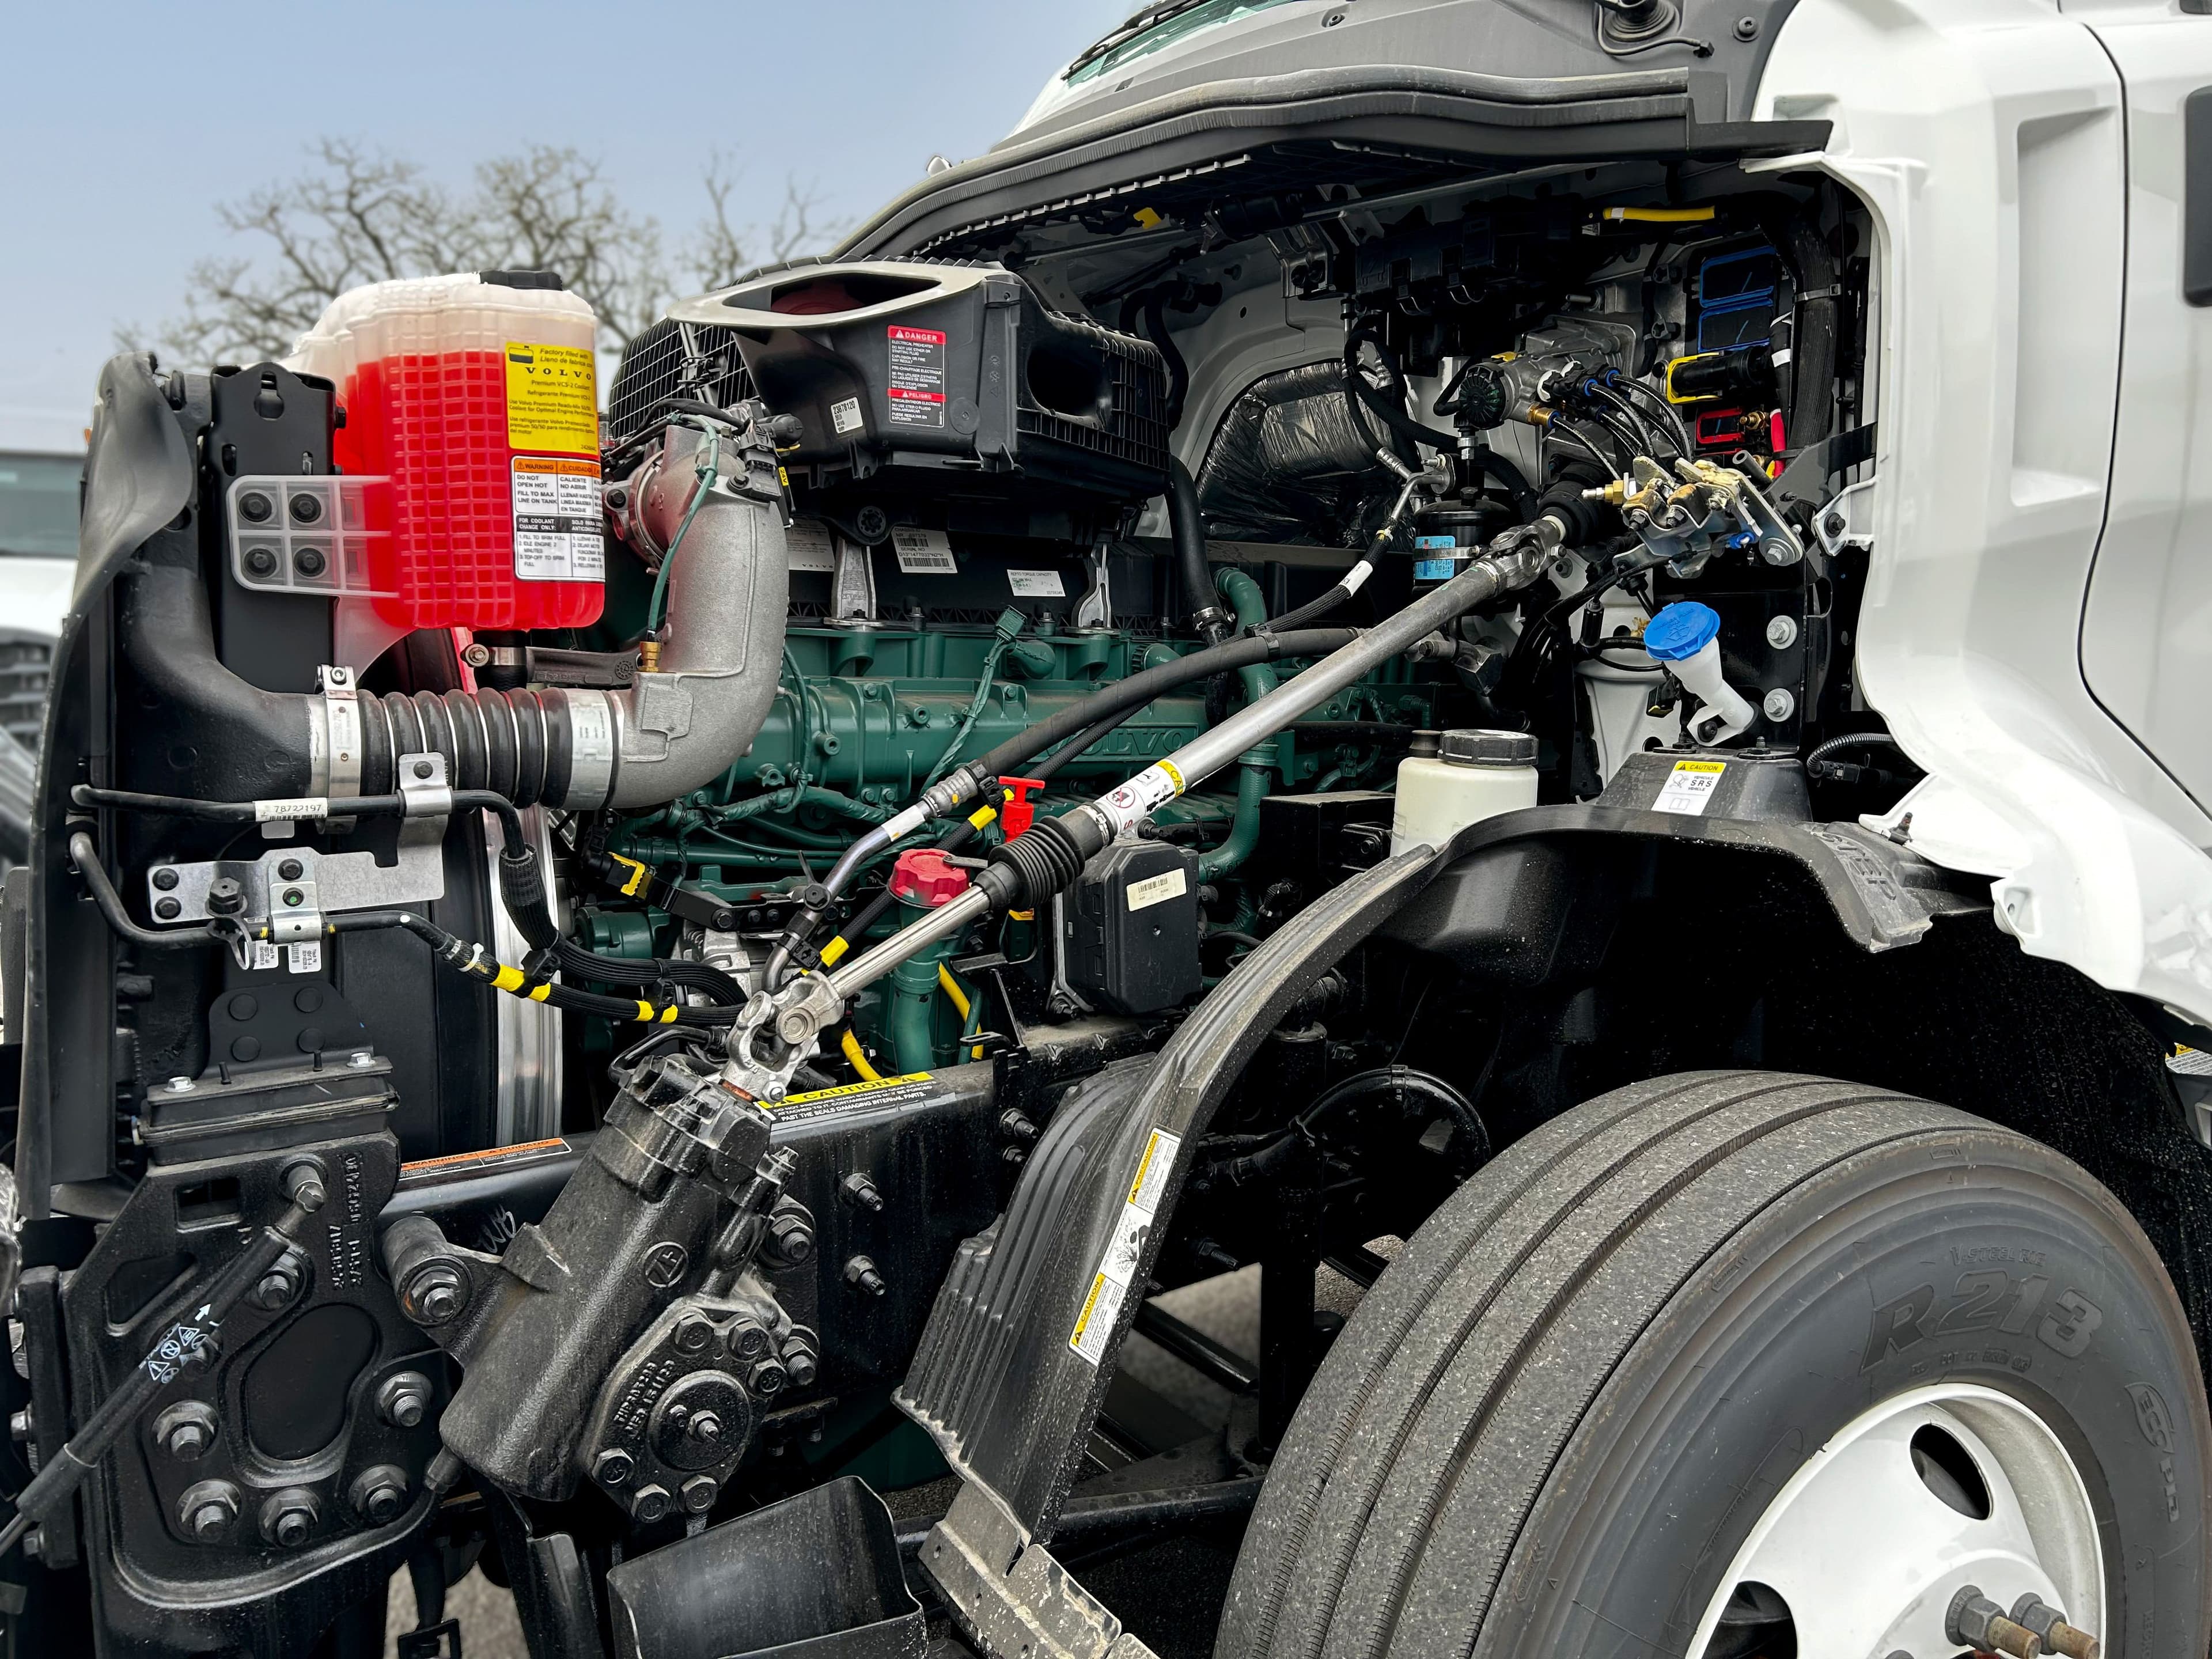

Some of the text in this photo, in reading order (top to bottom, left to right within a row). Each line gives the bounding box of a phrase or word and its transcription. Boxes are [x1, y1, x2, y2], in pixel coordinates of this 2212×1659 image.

[905, 332, 937, 342] DANGER
[525, 367, 591, 380] VOLVO
[274, 804, 322, 813] 78722197
[804, 1080, 891, 1100] CAUTION
[778, 1106, 811, 1116] ATTACHED
[814, 1107, 836, 1116] SEALS
[836, 1100, 872, 1112] DAMAGING
[499, 1141, 549, 1151] CUIDADO
[1950, 1244, 2016, 1266] V-STEEL
[1081, 1281, 1100, 1323] CAUTION
